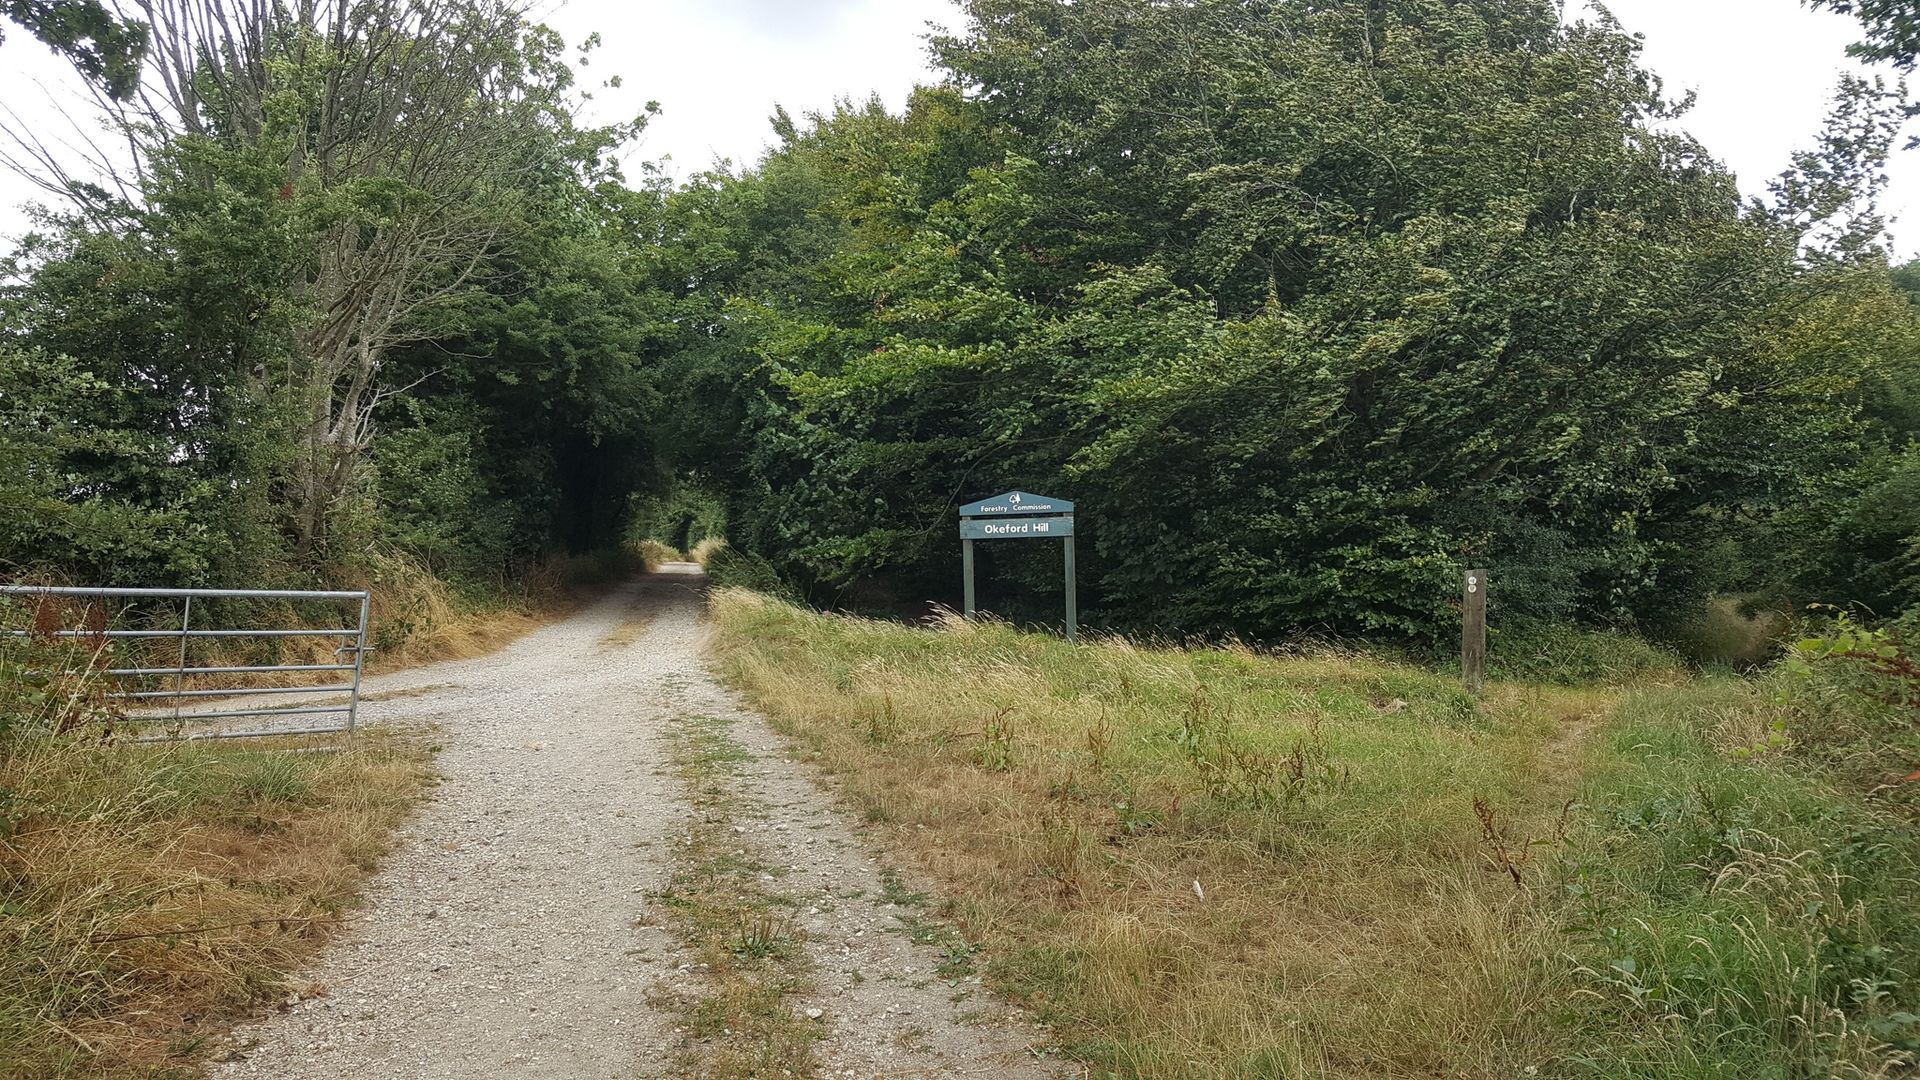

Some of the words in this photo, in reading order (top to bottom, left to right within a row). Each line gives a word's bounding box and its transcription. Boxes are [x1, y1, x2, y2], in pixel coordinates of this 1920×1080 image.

[980, 505, 1008, 513] Forestry
[1012, 503, 1051, 511] Commission
[984, 523, 1028, 534] Okeford
[1033, 522, 1049, 532] Hill
